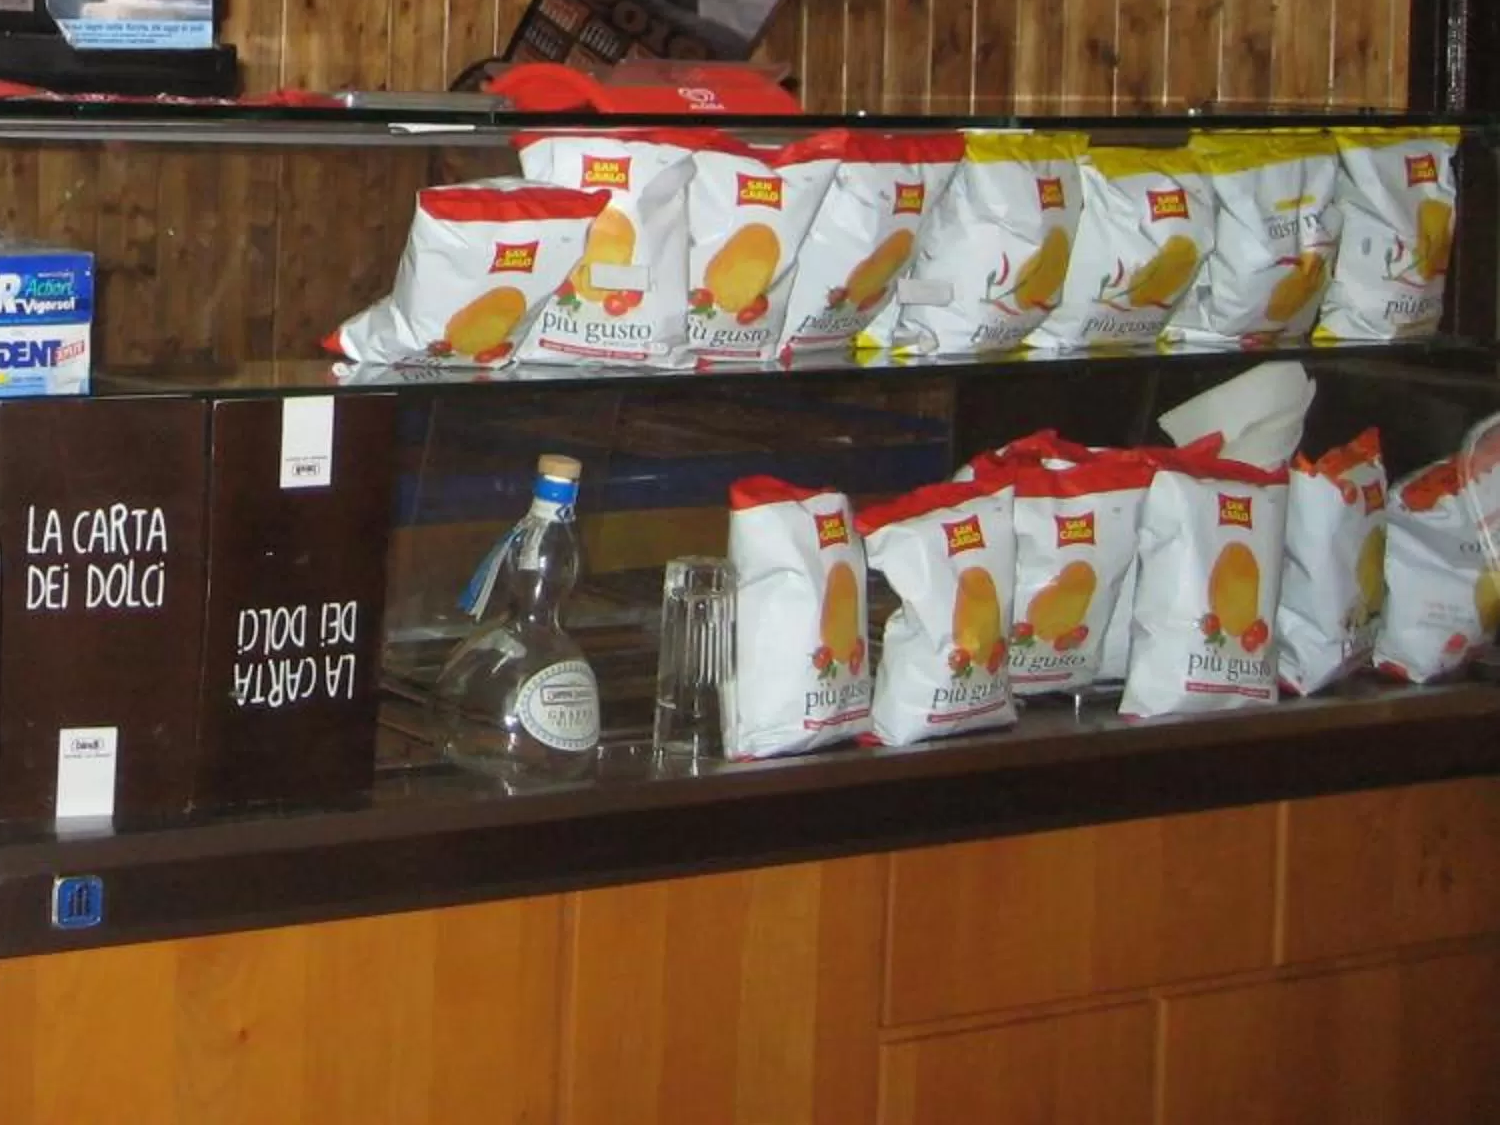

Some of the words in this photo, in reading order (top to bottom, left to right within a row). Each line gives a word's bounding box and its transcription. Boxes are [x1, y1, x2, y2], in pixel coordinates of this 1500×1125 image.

[593, 161, 619, 172] SAN
[585, 171, 626, 184] CARLO
[747, 179, 772, 190] SAN
[495, 256, 532, 269] CARLO
[505, 249, 529, 258] SAN
[25, 276, 74, 296] Action
[15, 296, 76, 315] Vigorsol
[541, 306, 578, 335] più
[584, 319, 653, 344] gusto
[712, 326, 769, 348] gusto
[1226, 500, 1245, 511] SAN
[1065, 518, 1086, 528] SAN
[1221, 509, 1249, 523] CARLO
[26, 504, 62, 555] LA
[72, 502, 168, 556] CARTA
[1060, 527, 1092, 540] CARLO
[1029, 656, 1087, 673] gusto
[1188, 647, 1222, 676] più
[1227, 658, 1272, 681] gusto
[234, 657, 316, 708] CARTA
[325, 653, 357, 700] LA
[805, 678, 837, 715] più
[932, 681, 964, 709] più
